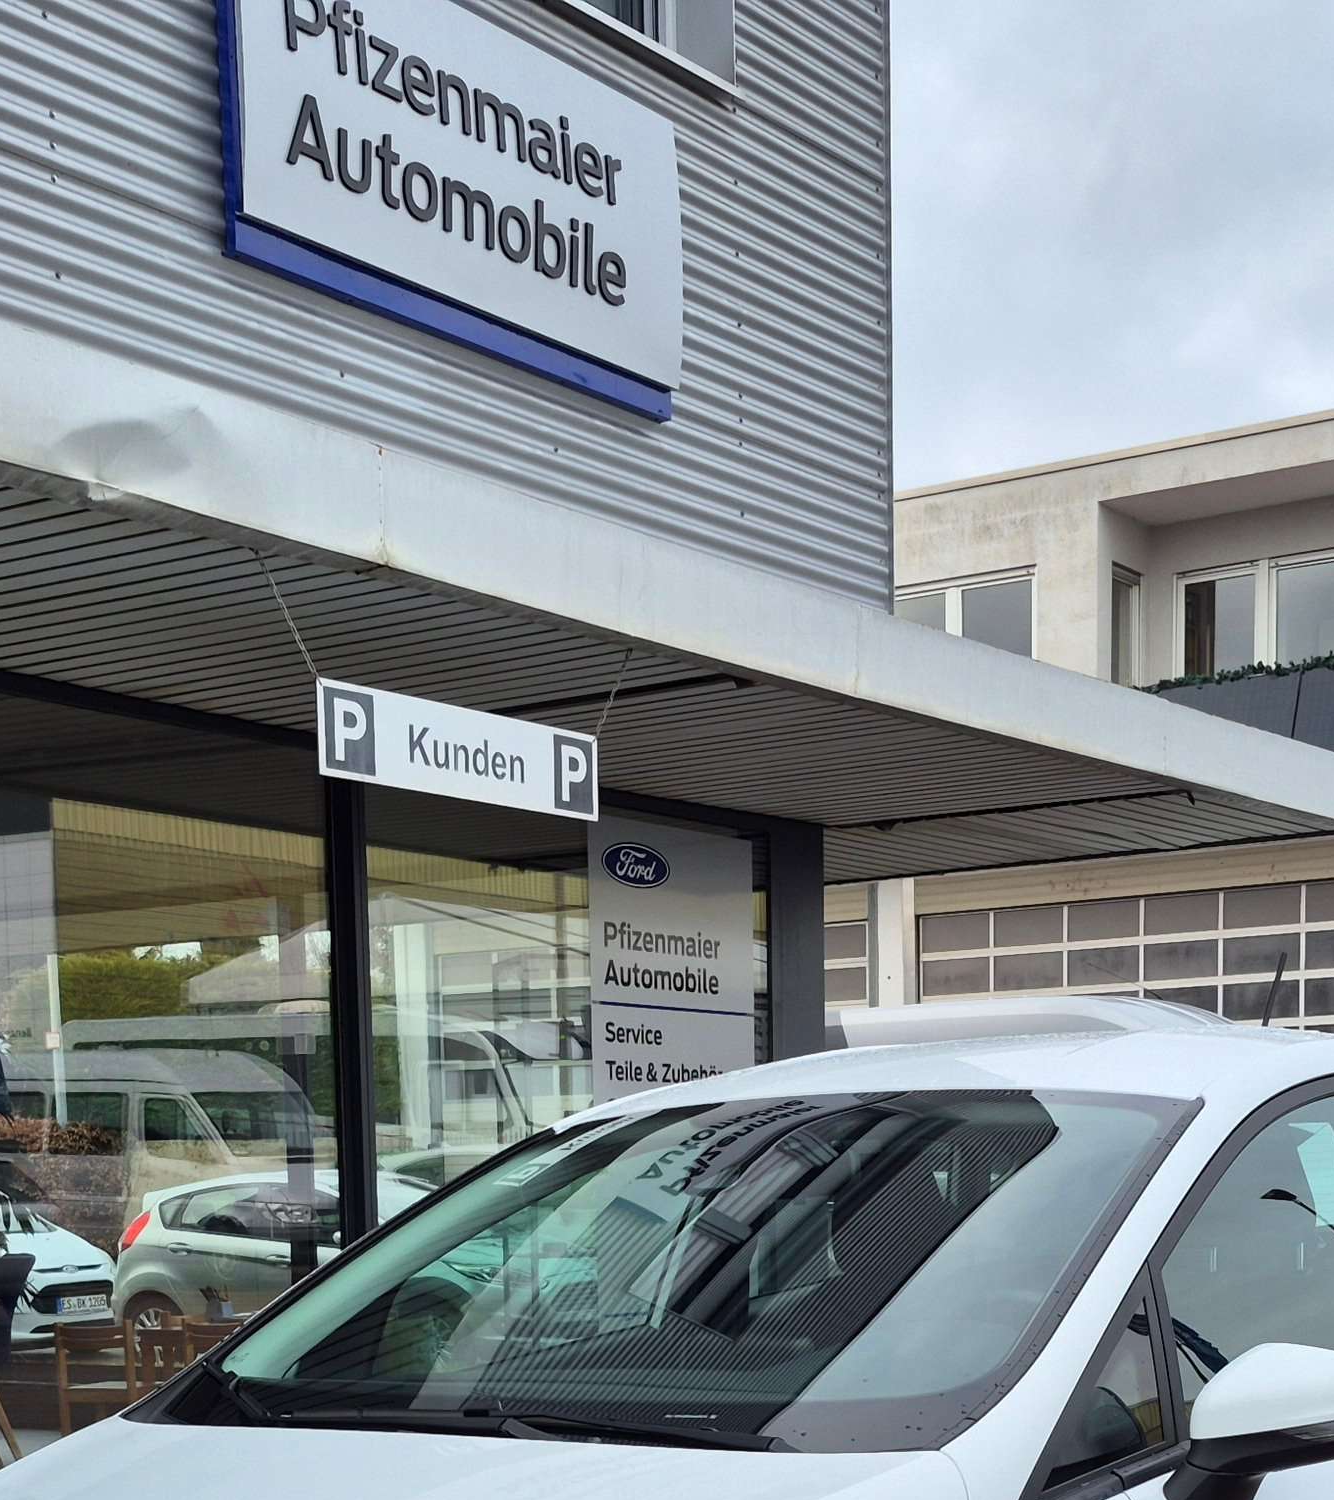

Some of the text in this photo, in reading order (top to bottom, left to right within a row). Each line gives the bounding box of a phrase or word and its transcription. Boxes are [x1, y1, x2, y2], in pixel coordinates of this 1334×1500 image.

[283, 0, 623, 206] Pfizenmaier
[286, 93, 628, 306] Automobile
[334, 696, 588, 803] P Kunden P
[614, 848, 657, 883] Ford
[604, 920, 720, 960] Pfizenmaier
[604, 959, 719, 995] Automobile
[605, 1021, 663, 1046] Service
[605, 1060, 723, 1084] Teile & Zubehö
